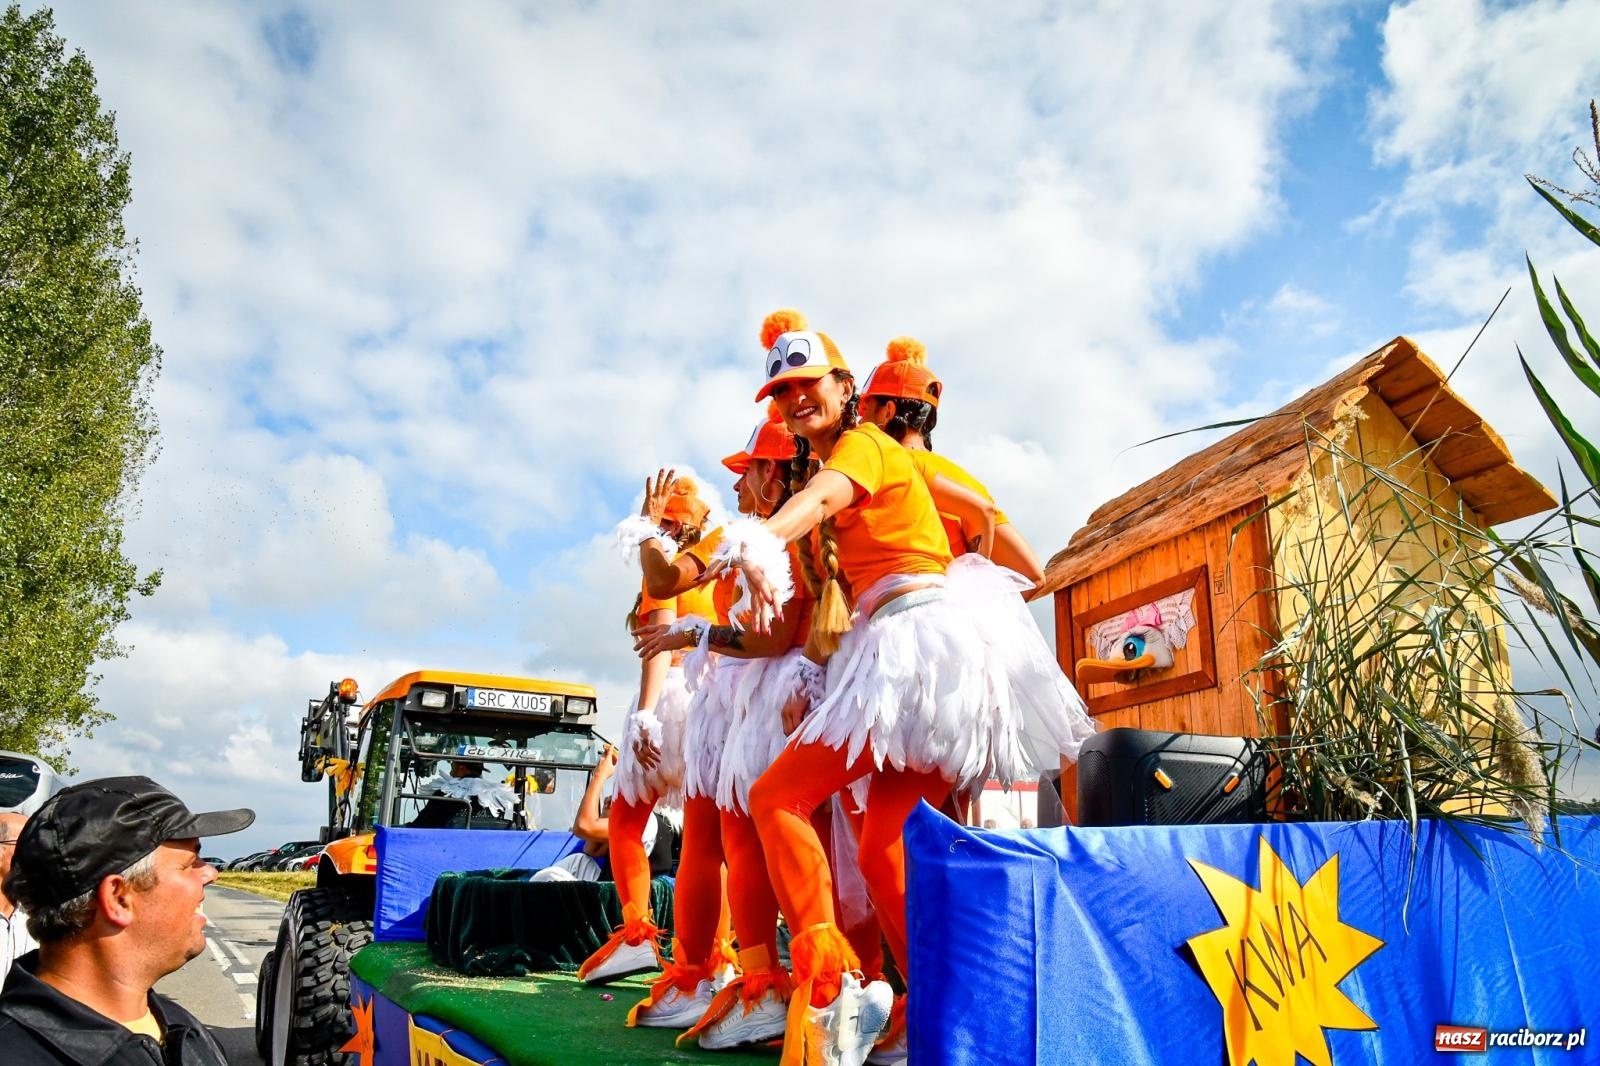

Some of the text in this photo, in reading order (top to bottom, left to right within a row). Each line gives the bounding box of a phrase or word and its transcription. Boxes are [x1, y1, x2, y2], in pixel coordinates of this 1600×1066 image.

[478, 691, 547, 711] SRC XU05
[1224, 901, 1327, 1031] KWA
